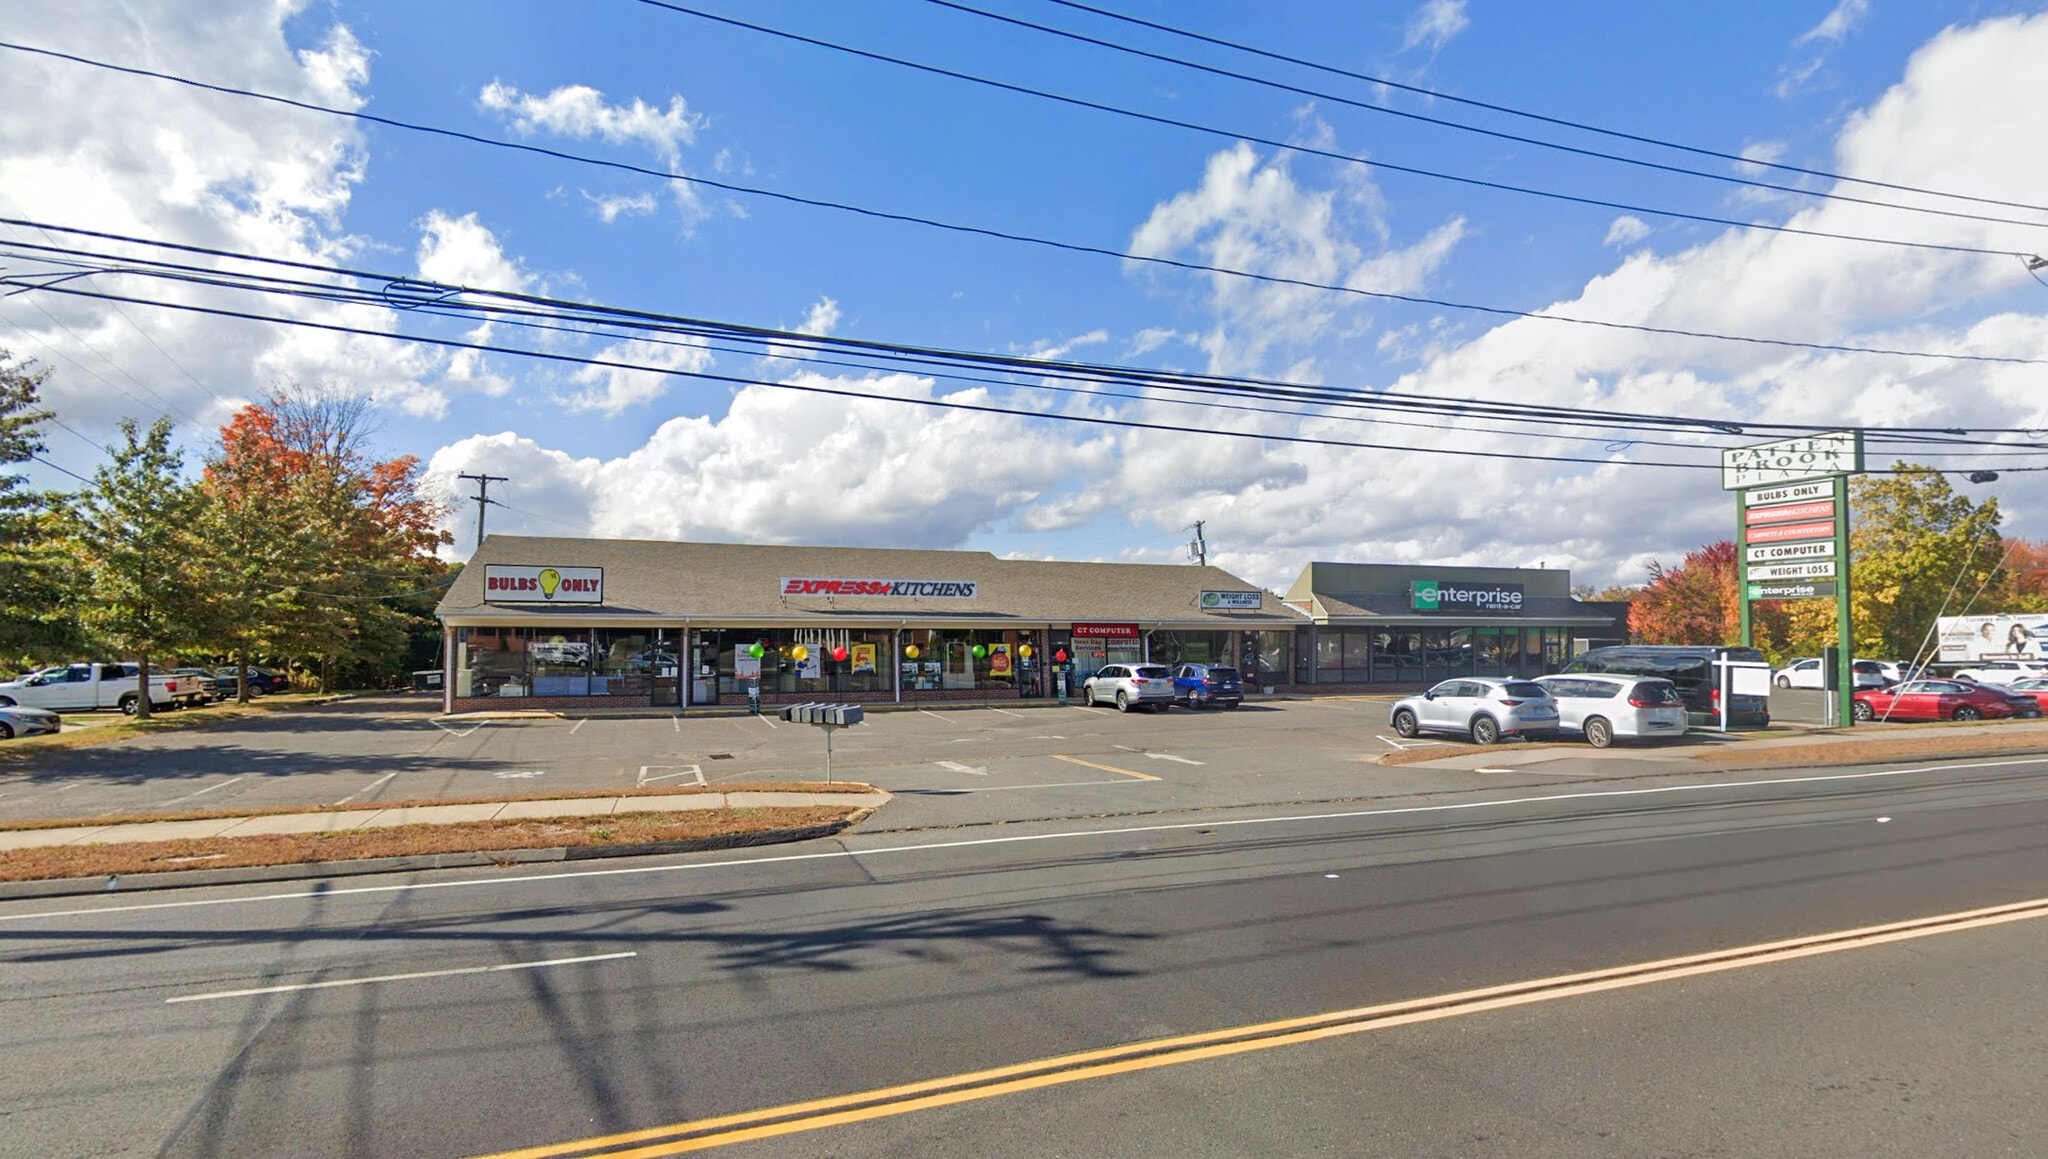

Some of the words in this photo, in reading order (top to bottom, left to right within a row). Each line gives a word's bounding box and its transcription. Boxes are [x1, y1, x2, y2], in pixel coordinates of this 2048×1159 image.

[1732, 436, 1845, 462] PATTEN
[1736, 449, 1840, 473] BROOK
[1737, 462, 1840, 484] PLAZA
[1757, 489, 1788, 501] BULBS
[1793, 486, 1819, 497] ONLY
[1754, 550, 1765, 559] CT
[1770, 545, 1826, 557] COMPUTER
[1770, 566, 1803, 576] WEIGHT
[1807, 565, 1829, 574] LOSS
[488, 577, 537, 591] BULBS
[561, 579, 599, 592] ONLY
[784, 580, 883, 595] EXPRESS
[889, 582, 975, 597] KITCHENS
[1751, 585, 1815, 596] enterprise
[1420, 587, 1522, 606] enterprise
[1486, 602, 1522, 610] rent-a-car
